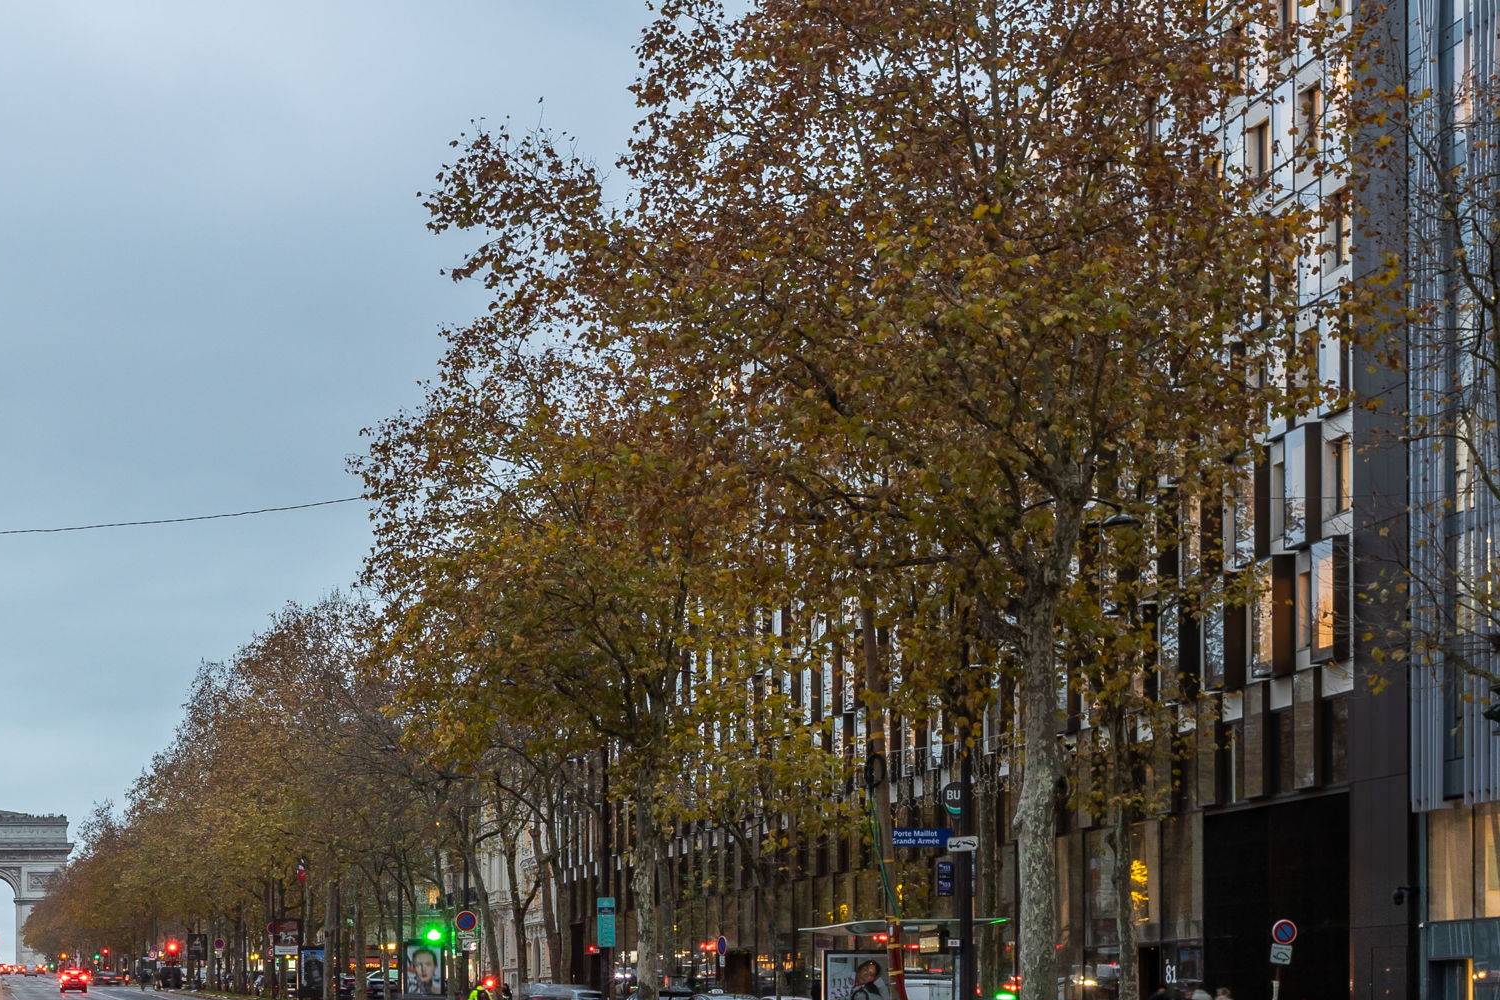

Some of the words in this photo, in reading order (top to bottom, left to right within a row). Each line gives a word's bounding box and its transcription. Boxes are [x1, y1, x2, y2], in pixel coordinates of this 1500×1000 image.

[947, 790, 961, 800] BU
[917, 837, 940, 845] Armée
[1165, 964, 1177, 984] 81
